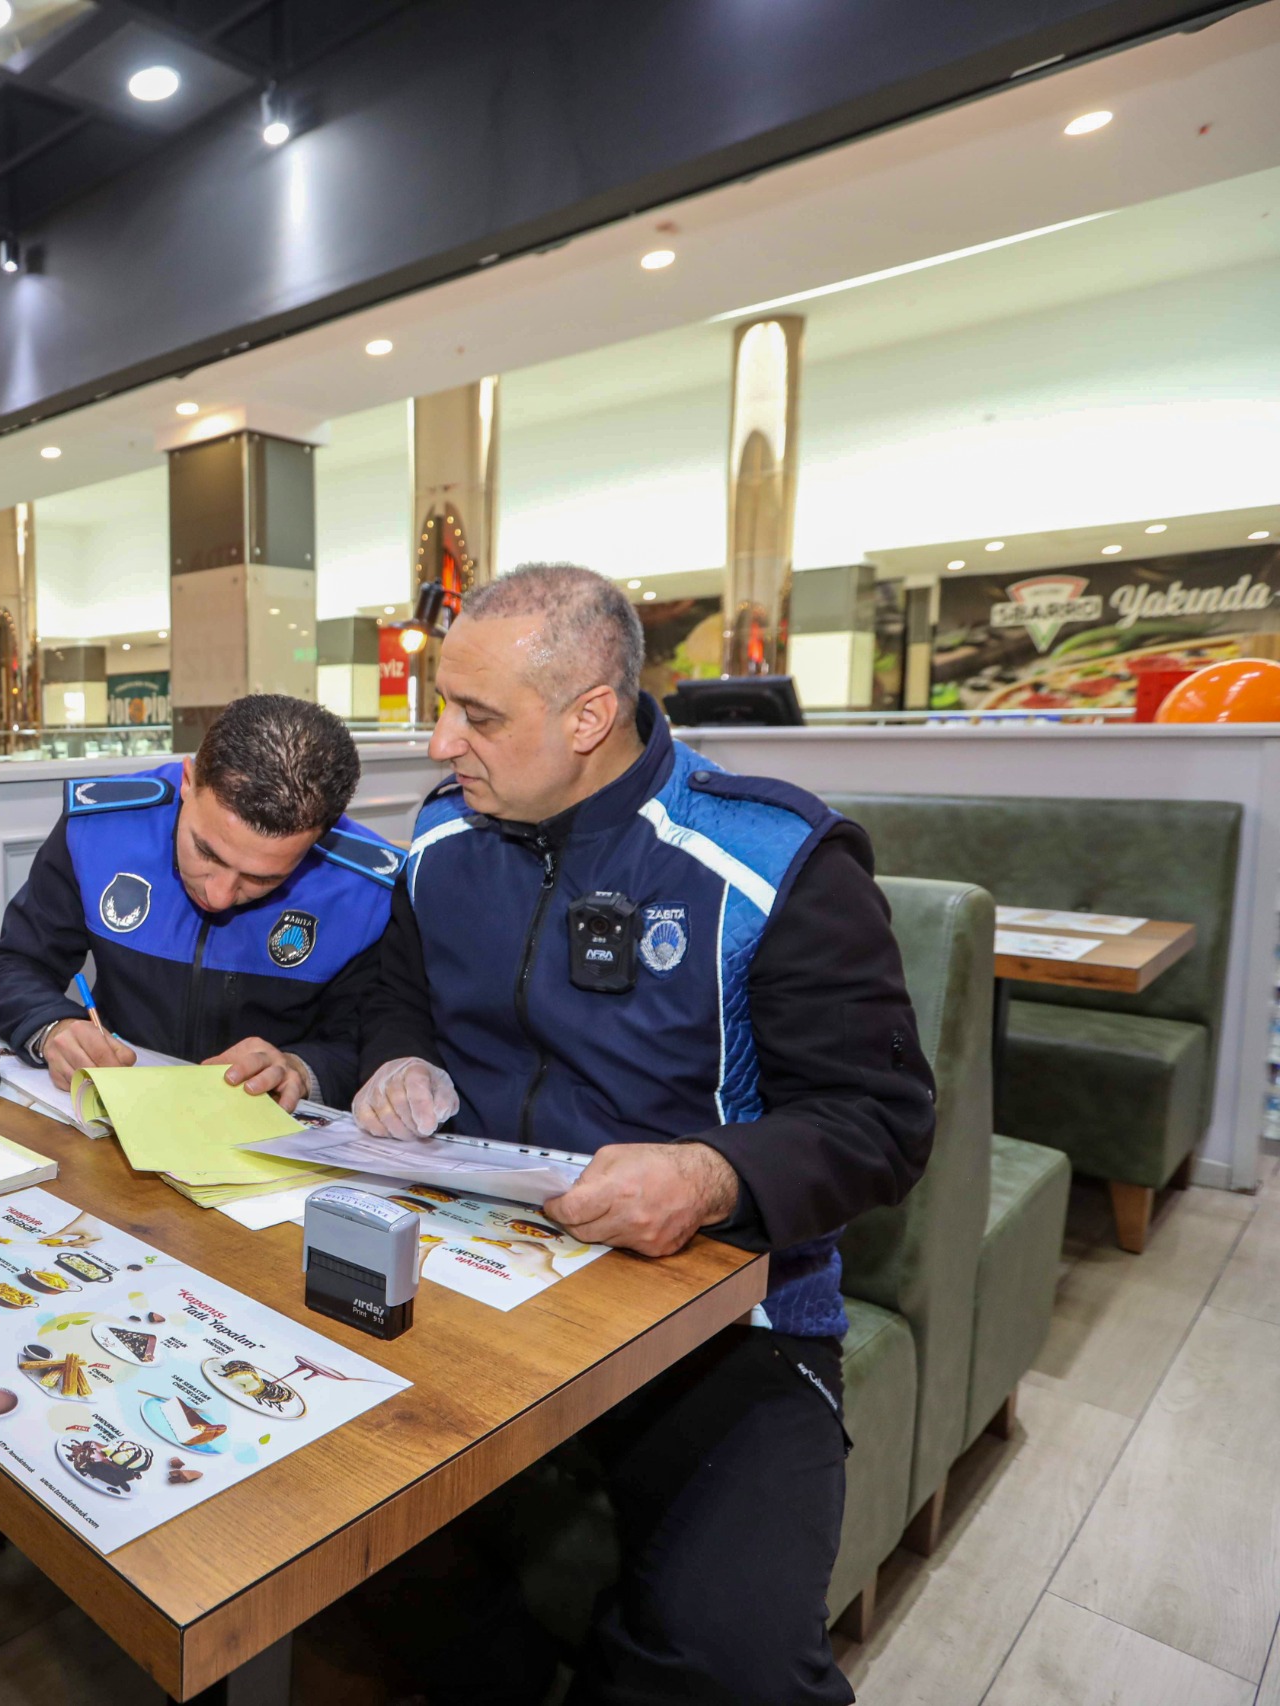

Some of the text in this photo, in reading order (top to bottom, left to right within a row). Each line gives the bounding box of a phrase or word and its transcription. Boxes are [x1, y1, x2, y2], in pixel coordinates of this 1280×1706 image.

[1110, 574, 1272, 630] Yakında
[646, 908, 685, 920] ZABITA
[182, 1305, 209, 1321] Tatlı
[352, 1306, 367, 1318] Print
[171, 1381, 206, 1404] CHEESECAKE
